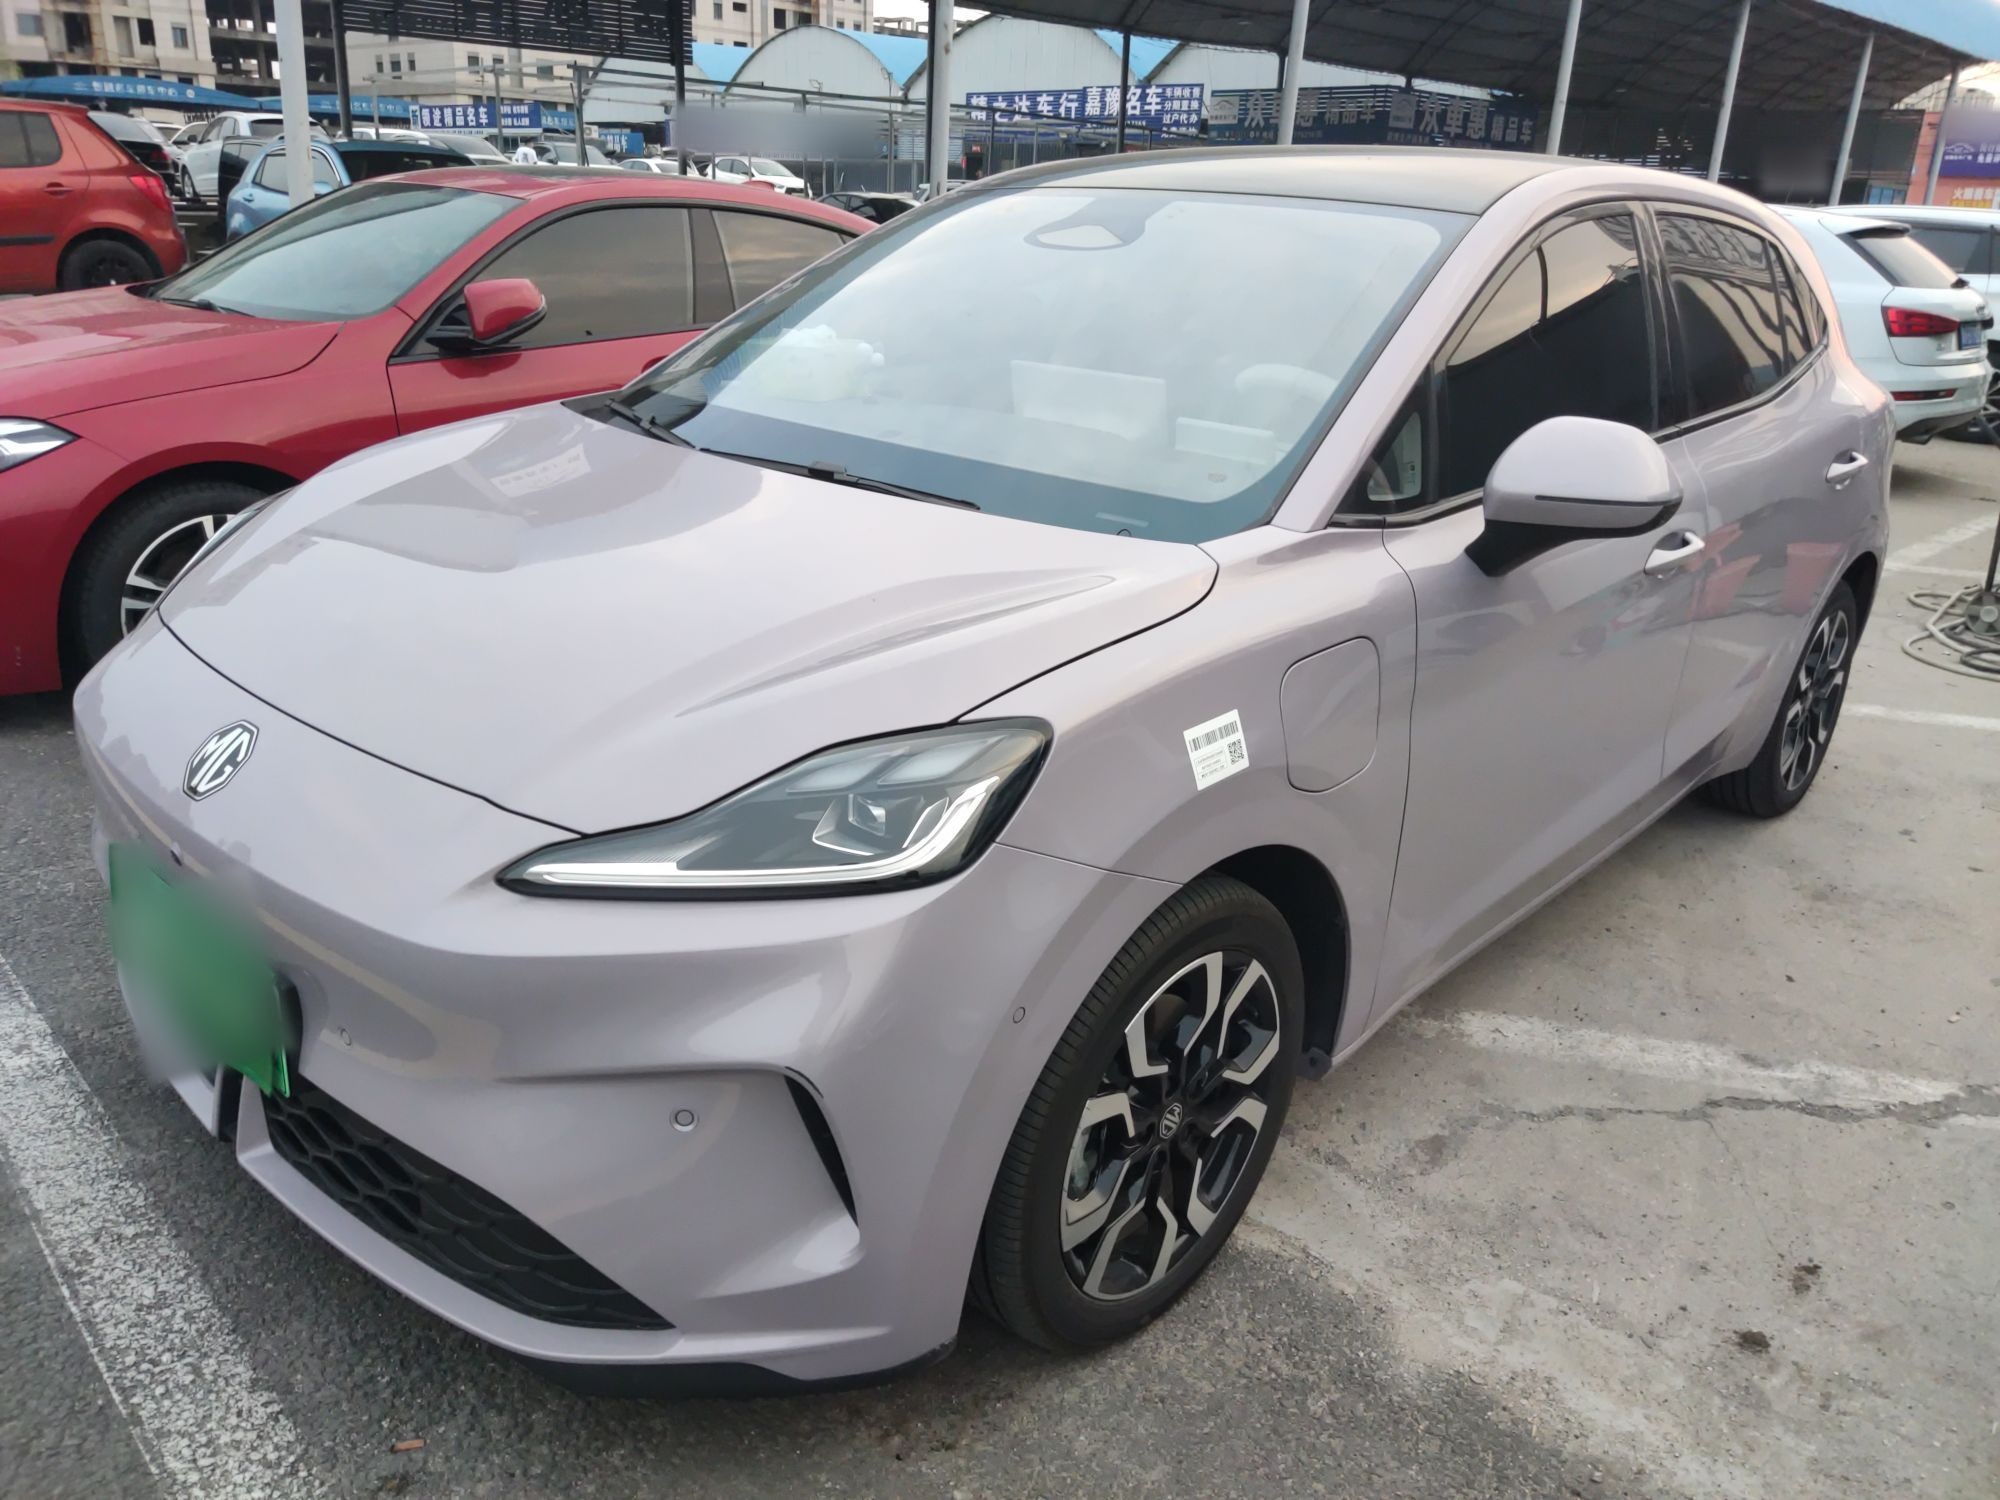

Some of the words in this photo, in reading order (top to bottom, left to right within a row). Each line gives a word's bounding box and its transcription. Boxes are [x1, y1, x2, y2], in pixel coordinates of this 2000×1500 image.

[1084, 86, 1162, 116] 嘉豫名车
[1162, 113, 1198, 124] 过户代办
[188, 724, 254, 796] MG
